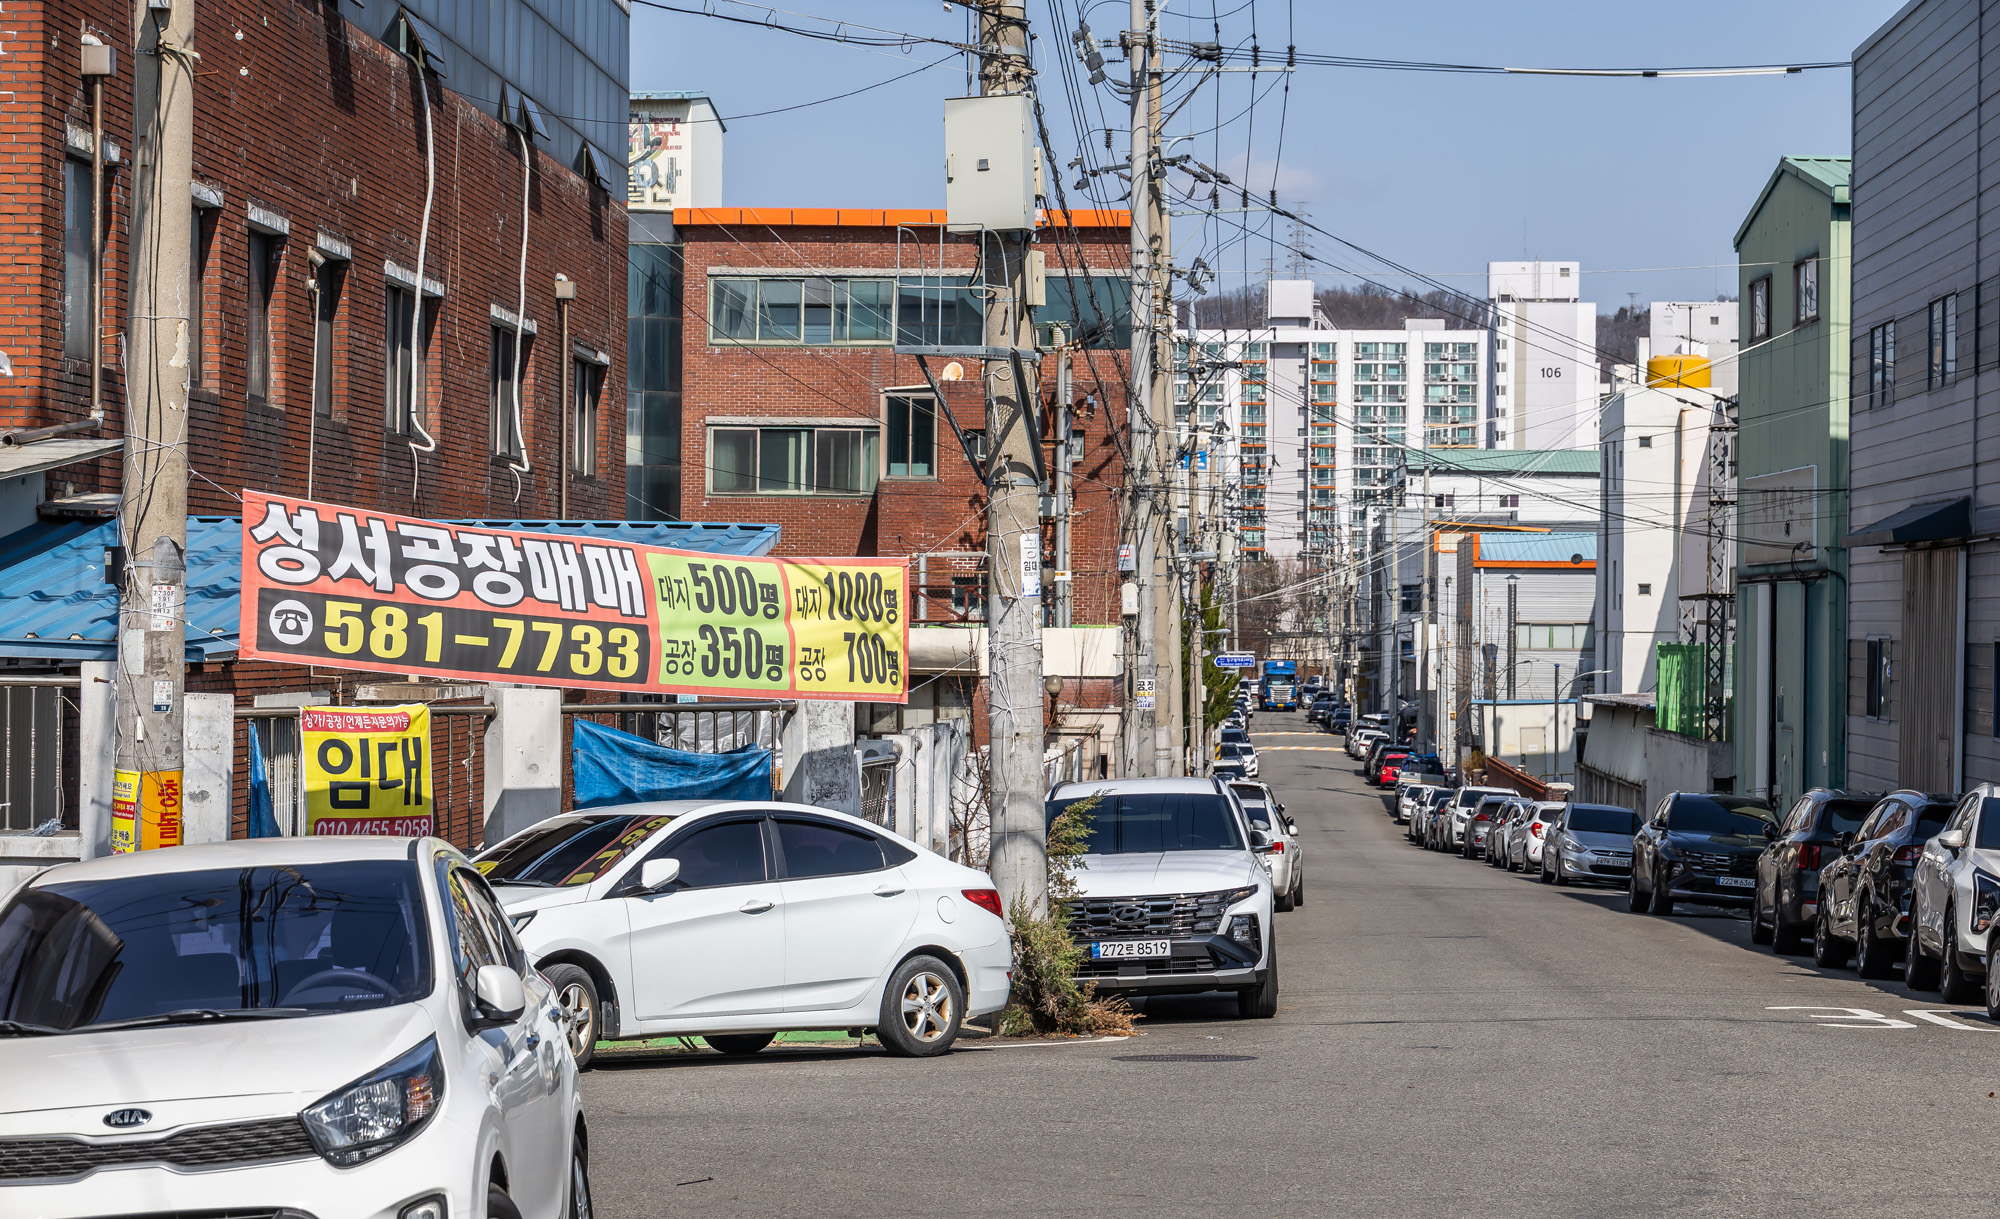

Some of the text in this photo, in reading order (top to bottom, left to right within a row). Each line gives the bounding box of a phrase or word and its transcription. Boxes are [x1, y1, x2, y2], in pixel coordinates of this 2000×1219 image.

[1541, 367, 1562, 378] 106
[658, 575, 691, 611] 대지
[796, 585, 822, 621] 대지
[324, 600, 640, 678] 581-7733
[665, 639, 696, 676] 공장
[799, 647, 826, 682] 공장
[317, 737, 423, 810] 임대
[316, 818, 429, 836] 010 4455 5058
[1102, 942, 1168, 957] 272로 8519
[110, 1110, 143, 1124] KIA
